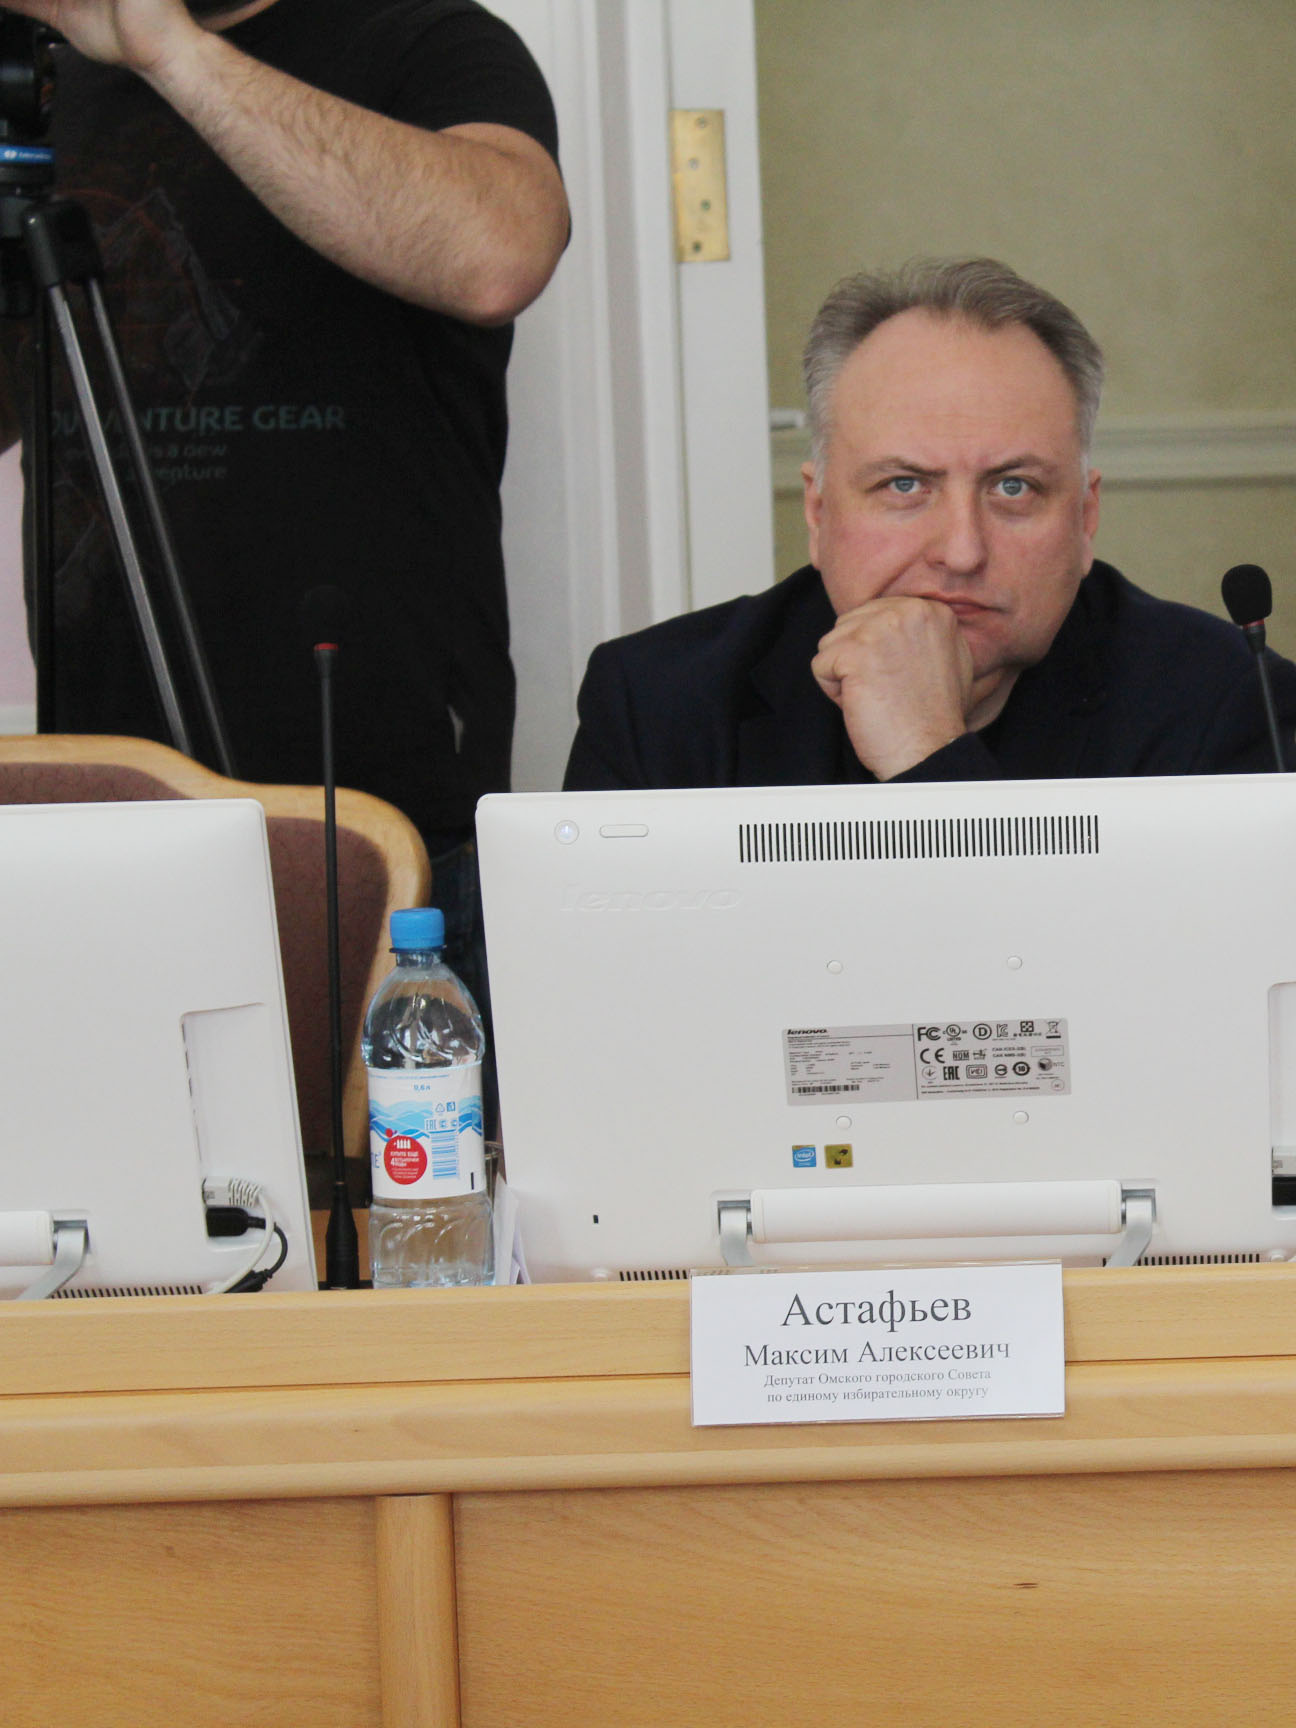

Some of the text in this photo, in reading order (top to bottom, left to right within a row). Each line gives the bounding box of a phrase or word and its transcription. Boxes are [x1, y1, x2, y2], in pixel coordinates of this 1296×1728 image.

[252, 405, 345, 430] GEAR
[183, 444, 227, 458] new
[920, 1048, 945, 1064] CE
[780, 1290, 971, 1332] Астафьев
[744, 1341, 1010, 1367] Максим Алексеевич
[764, 1369, 991, 1388] Депутат Омского городского Совета
[768, 1386, 989, 1403] по единому избирательному округу
